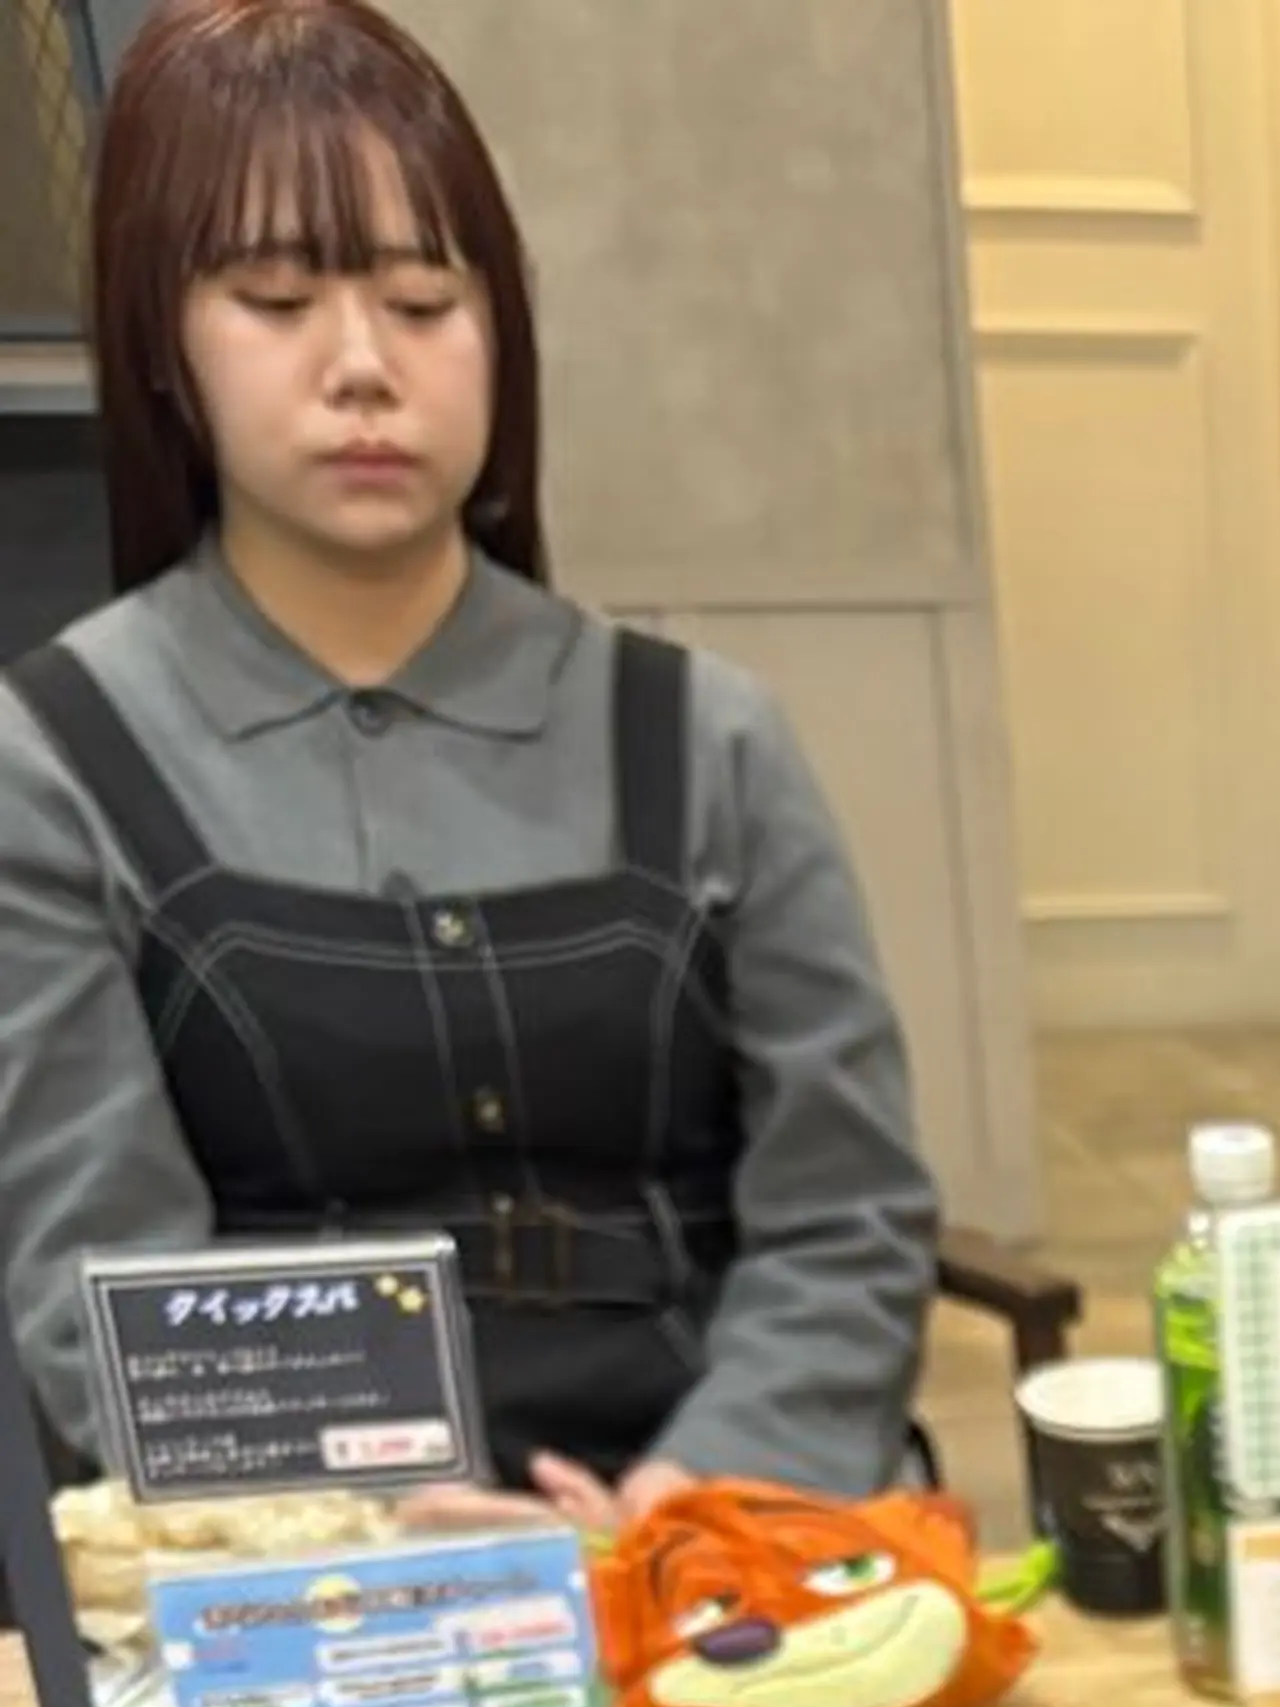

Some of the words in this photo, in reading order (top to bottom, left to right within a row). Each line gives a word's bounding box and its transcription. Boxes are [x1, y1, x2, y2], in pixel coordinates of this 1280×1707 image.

[164, 1281, 360, 1326] クイックスパ
